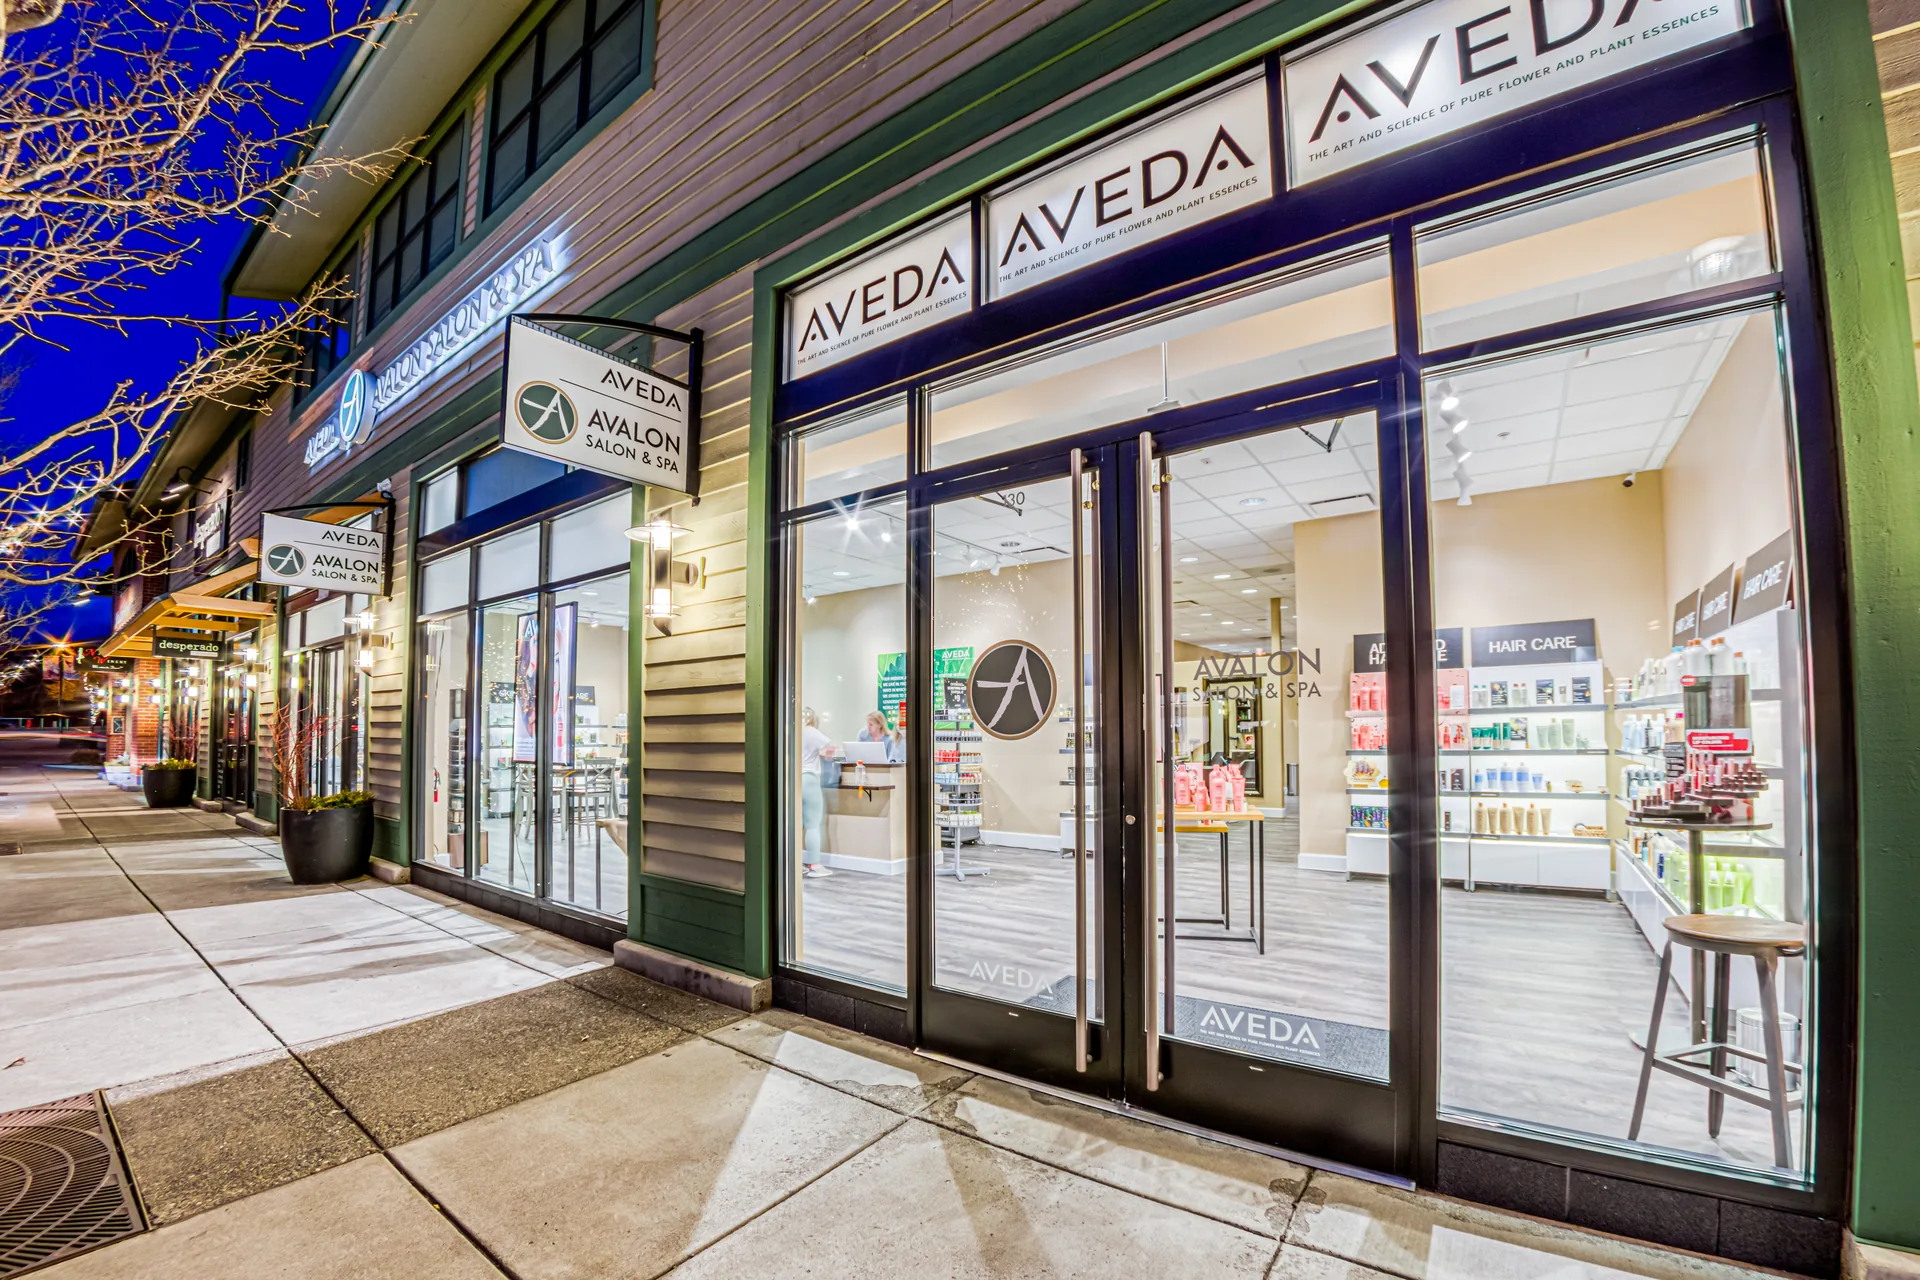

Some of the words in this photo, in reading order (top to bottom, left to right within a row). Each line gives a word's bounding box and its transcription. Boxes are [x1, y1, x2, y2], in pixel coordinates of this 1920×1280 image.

[1308, 148, 1329, 162] THE
[1333, 139, 1355, 153] ART
[1358, 129, 1382, 144] AND
[1386, 109, 1435, 133] SCIENCE
[1440, 100, 1455, 113] OF
[1461, 87, 1493, 105] PURE
[1499, 66, 1551, 92] FLOWER
[1556, 54, 1584, 71] AND
[1590, 35, 1636, 59] PLANT
[1642, 5, 1719, 40] ESSENCES
[1309, 0, 1662, 143] AVED
[1000, 124, 1255, 267] AVEDA
[999, 273, 1011, 283] THE
[1014, 266, 1028, 277] ART
[1030, 260, 1046, 270] AND
[1048, 246, 1079, 263] SCIENCE
[1082, 240, 1092, 249] OF
[1095, 231, 1116, 244] PURE
[1119, 217, 1152, 235] FLOWER
[1155, 209, 1173, 222] AND
[1176, 196, 1205, 213] PLANT
[1209, 176, 1258, 200] ESSENCES
[511, 239, 554, 294] SPA
[798, 246, 965, 352] AVEDA
[807, 353, 817, 361] ART
[818, 348, 829, 356] AND
[830, 339, 851, 351] SCIENCE
[852, 335, 860, 343] OF
[861, 329, 875, 339] PURE
[876, 319, 898, 332] FLOWER
[900, 314, 913, 323] AND
[914, 305, 933, 317] PLANT
[935, 291, 967, 308] ESSENCES
[601, 368, 682, 412] AVEDA
[588, 409, 680, 456] AVALON
[586, 434, 636, 460] SALON
[642, 451, 652, 465] &
[656, 456, 679, 473] SPA
[322, 530, 380, 548] AVEDA
[312, 569, 347, 580] SALON
[361, 575, 378, 585] SPA
[313, 554, 379, 573] AVALON
[159, 640, 219, 652] desperado
[942, 650, 970, 659] AVEDA
[1193, 648, 1321, 681] AVALON
[1488, 639, 1527, 653] HAIR
[1530, 635, 1577, 651] CARE
[1193, 685, 1256, 701] SALON
[1265, 683, 1278, 699] &
[1286, 682, 1322, 698] SPA
[969, 961, 1053, 994] AVEDA
[1200, 1005, 1320, 1049] AVEDA
